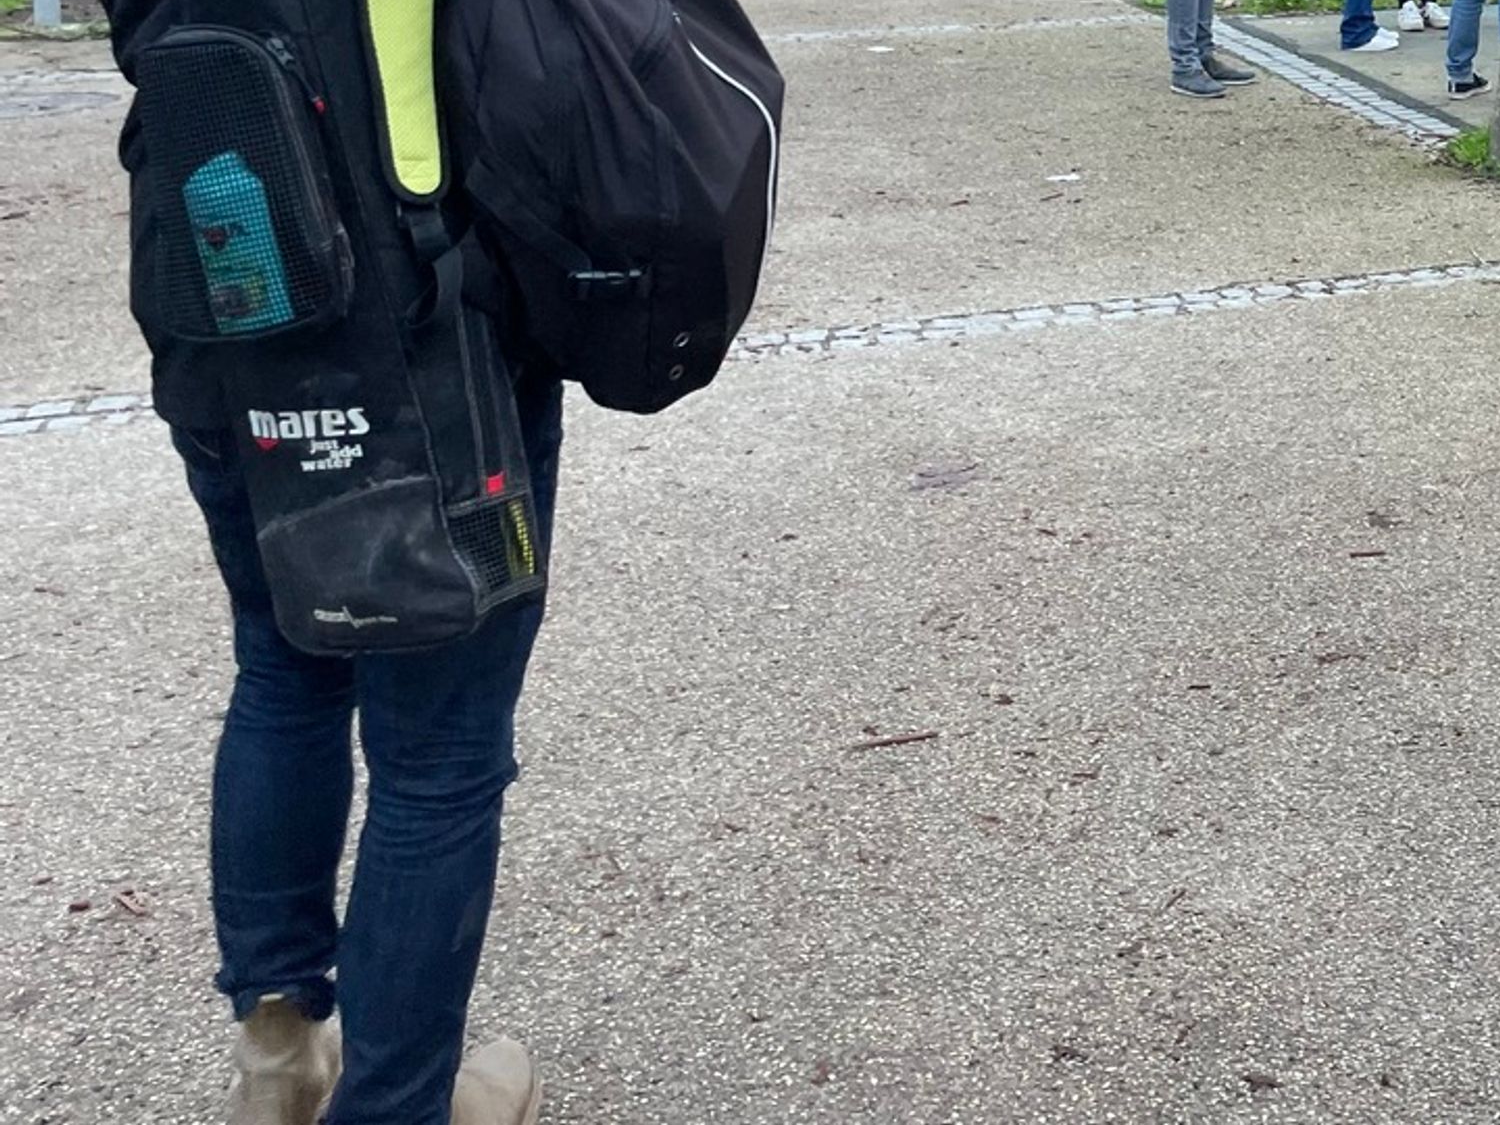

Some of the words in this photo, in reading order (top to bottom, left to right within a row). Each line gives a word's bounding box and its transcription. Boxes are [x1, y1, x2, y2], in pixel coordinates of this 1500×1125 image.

[248, 408, 370, 439] mares
[310, 439, 338, 454] just
[329, 444, 363, 457] add
[301, 458, 352, 472] water
